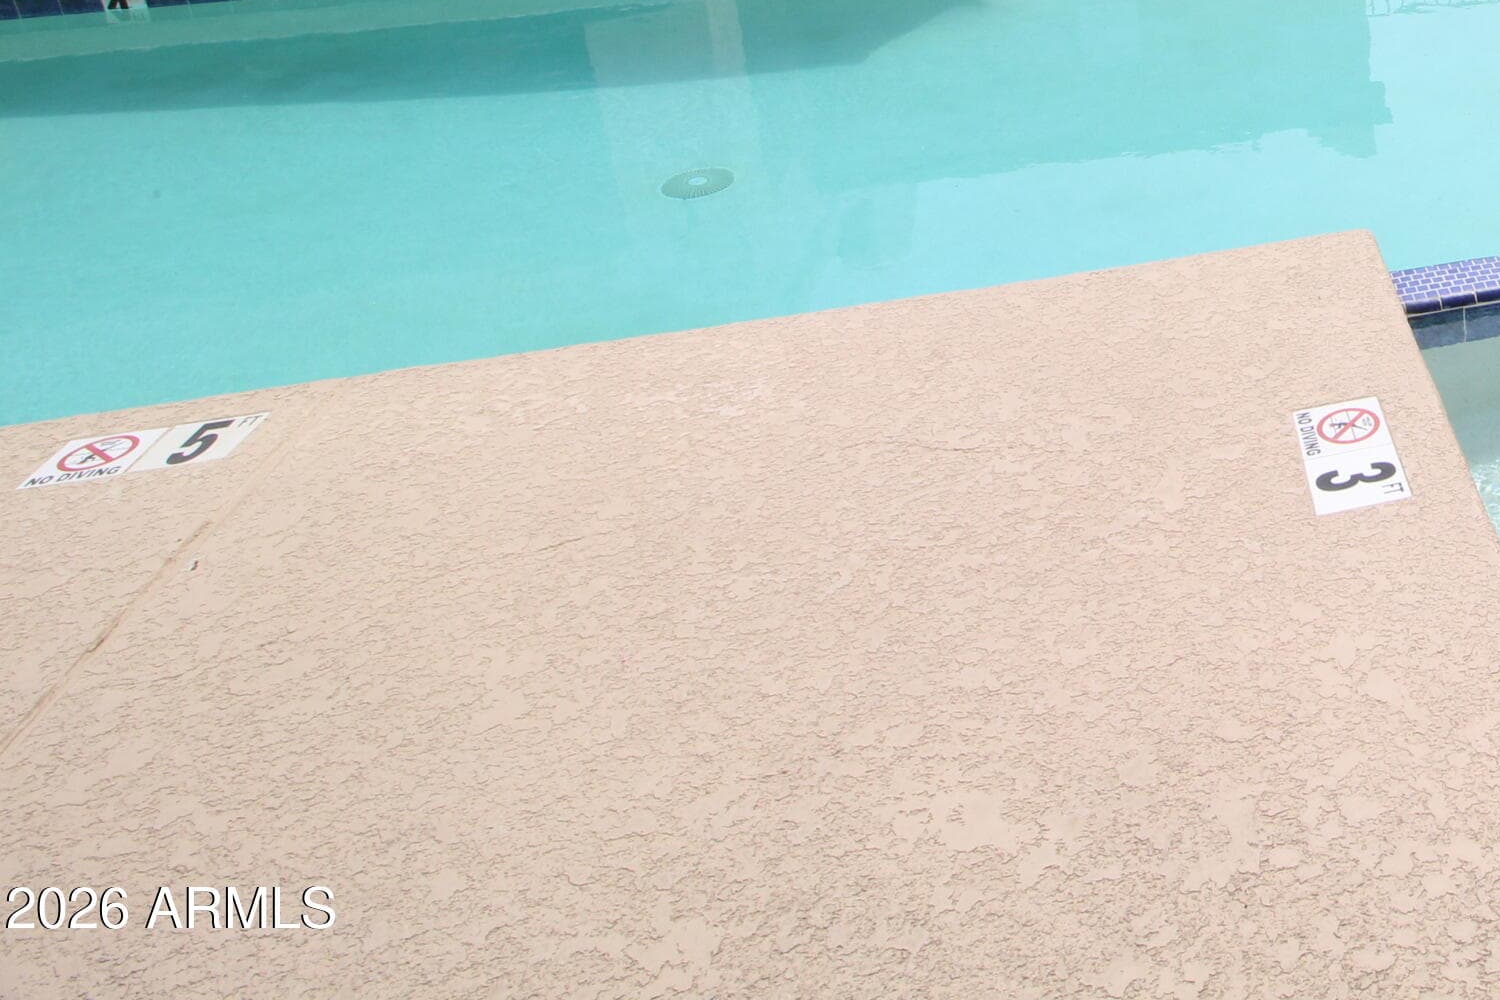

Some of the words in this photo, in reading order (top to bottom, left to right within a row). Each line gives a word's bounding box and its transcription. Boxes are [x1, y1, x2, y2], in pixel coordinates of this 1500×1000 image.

[1296, 411, 1312, 425] NO
[166, 419, 236, 465] 5
[237, 414, 263, 428] FT
[1300, 425, 1321, 456] DIVING
[24, 475, 54, 487] NO
[56, 466, 122, 482] DIVING
[1315, 461, 1397, 491] 3
[1381, 482, 1404, 495] FT
